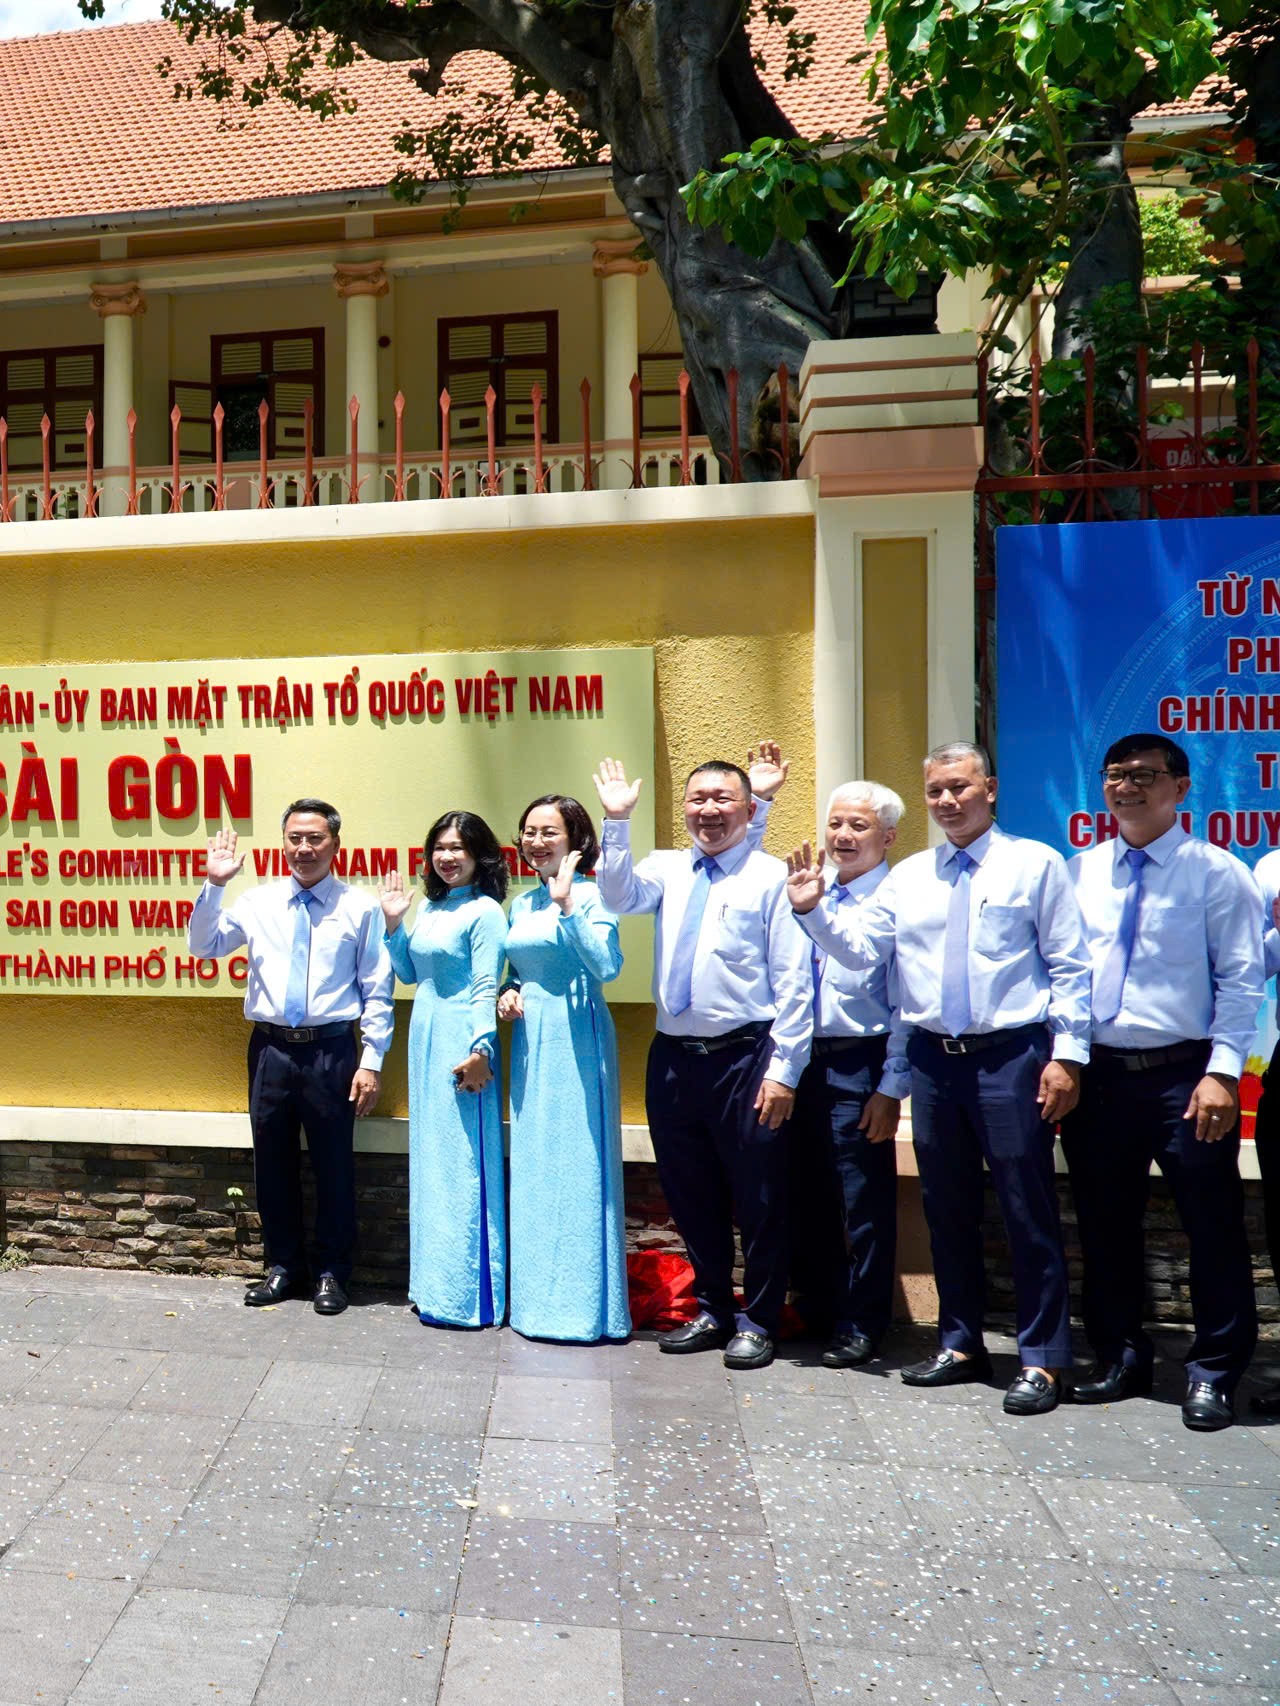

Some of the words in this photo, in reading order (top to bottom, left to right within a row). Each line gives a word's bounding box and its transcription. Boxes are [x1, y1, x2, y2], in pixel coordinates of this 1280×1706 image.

[1198, 572, 1252, 617] TỪ
[54, 678, 89, 725] ỦY
[100, 687, 157, 723] BAN
[167, 678, 228, 728] MẶT
[237, 675, 314, 726] TRẬN
[323, 666, 360, 718] TỔ
[368, 667, 446, 721] QUỐC
[454, 669, 518, 721] VIỆT
[529, 674, 604, 713] NAM
[1160, 689, 1280, 731] CHÍNH
[107, 736, 253, 822] GÒN
[58, 849, 209, 879] COMMITTE
[5, 899, 52, 928] SAI
[59, 899, 119, 929] GON
[128, 899, 194, 929] WAR
[103, 945, 167, 981] PHỐ
